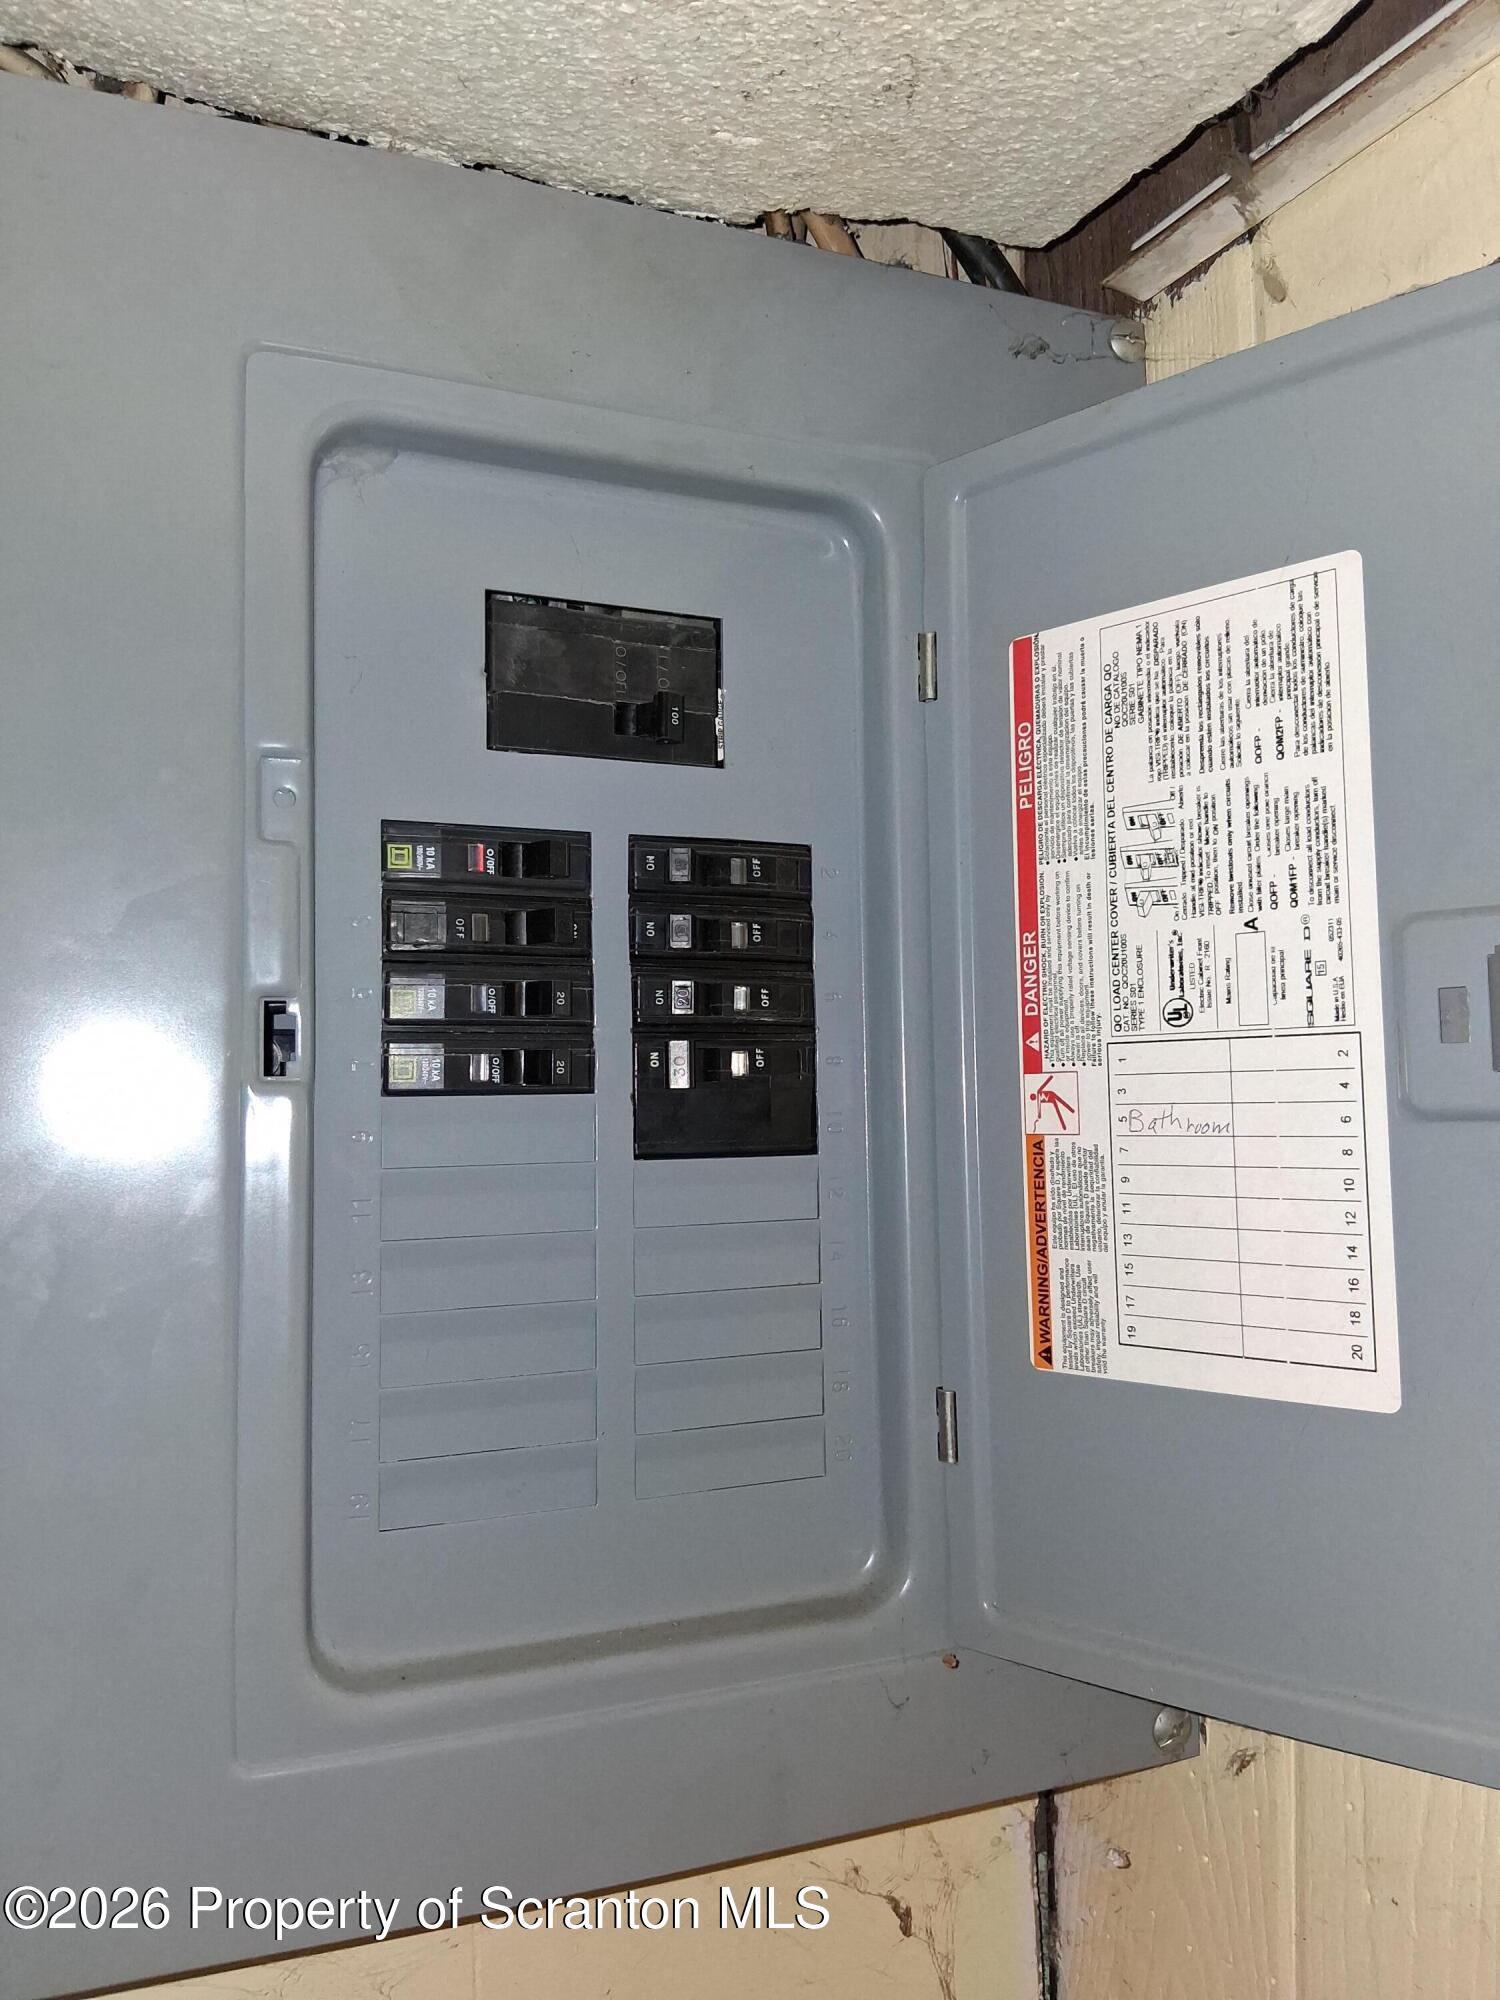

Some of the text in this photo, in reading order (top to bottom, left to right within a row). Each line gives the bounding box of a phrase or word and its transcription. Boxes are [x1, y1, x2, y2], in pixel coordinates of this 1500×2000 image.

[1135, 630, 1143, 656] NEMA
[1103, 664, 1113, 681] QO
[1135, 658, 1143, 678] TIPO
[1034, 684, 1042, 735] QUEMADURAS
[1104, 684, 1114, 725] CARGA
[1113, 702, 1120, 714] DE
[1128, 684, 1136, 725] SERIE S01
[1136, 680, 1144, 723] GABINETE
[670, 705, 679, 726] 100
[1113, 715, 1120, 728] NO
[1105, 728, 1114, 743] DE
[1275, 716, 1285, 760] QOM2FP
[1254, 736, 1263, 764] QOFP
[1018, 722, 1033, 809] PELIGRO
[1105, 746, 1116, 793] CENTRO
[1107, 796, 1116, 818] DEL
[1037, 822, 1043, 832] DE
[426, 846, 434, 870] 10 kA
[1107, 821, 1118, 878] CUBIERTA
[486, 848, 494, 876] O/OFF
[646, 856, 656, 871] ON
[752, 858, 761, 877] OFF
[1085, 882, 1093, 901] death
[1269, 881, 1278, 909] QOFP
[1289, 864, 1298, 908] QOM1FP
[1109, 888, 1119, 928] COVER
[456, 918, 464, 939] OFF
[646, 921, 656, 937] ON
[1040, 916, 1046, 927] OR
[1086, 911, 1094, 932] result
[1244, 917, 1258, 930] A
[752, 924, 762, 942] OFF
[1110, 930, 1120, 976] CENTER
[1120, 934, 1129, 991] QOC20U100S
[1023, 931, 1039, 1016] DANGER
[1087, 947, 1095, 988] instructions
[1136, 945, 1144, 999] ENCLOSURE
[1196, 938, 1206, 1013] Electric Cabinet Front
[556, 991, 565, 1005] 20
[655, 990, 665, 1005] ON
[760, 988, 770, 1007] OFF
[1112, 979, 1121, 1011] LOAD
[1205, 989, 1213, 1008] Issue
[1303, 950, 1314, 1026] SQUARE
[427, 988, 436, 1010] 10 kA
[487, 988, 496, 1014] O/OFF
[1088, 989, 1096, 1010] these
[1042, 1017, 1048, 1028] OF
[1112, 1014, 1122, 1032] QO
[650, 1052, 660, 1068] ON
[756, 1048, 765, 1067] OFF
[1095, 1039, 1104, 1066] serious
[431, 1058, 440, 1081] 10 kA
[491, 1058, 500, 1083] O/OFF
[556, 1060, 565, 1074] 20
[673, 1056, 686, 1077] 30
[1129, 1104, 1230, 1134] Bathroom
[1343, 1178, 1355, 1192] 10
[1122, 1203, 1131, 1214] 11
[1345, 1211, 1356, 1226] 12
[1033, 1140, 1050, 1344] WARNING/ADVERTENCIA
[1123, 1234, 1132, 1246] 13
[1346, 1246, 1358, 1260] 14
[1124, 1263, 1134, 1276] 15
[1348, 1278, 1360, 1293] 16
[1126, 1295, 1135, 1308] 17
[1350, 1311, 1361, 1325] 18
[1127, 1326, 1136, 1339] 19
[1351, 1344, 1363, 1360] 20
